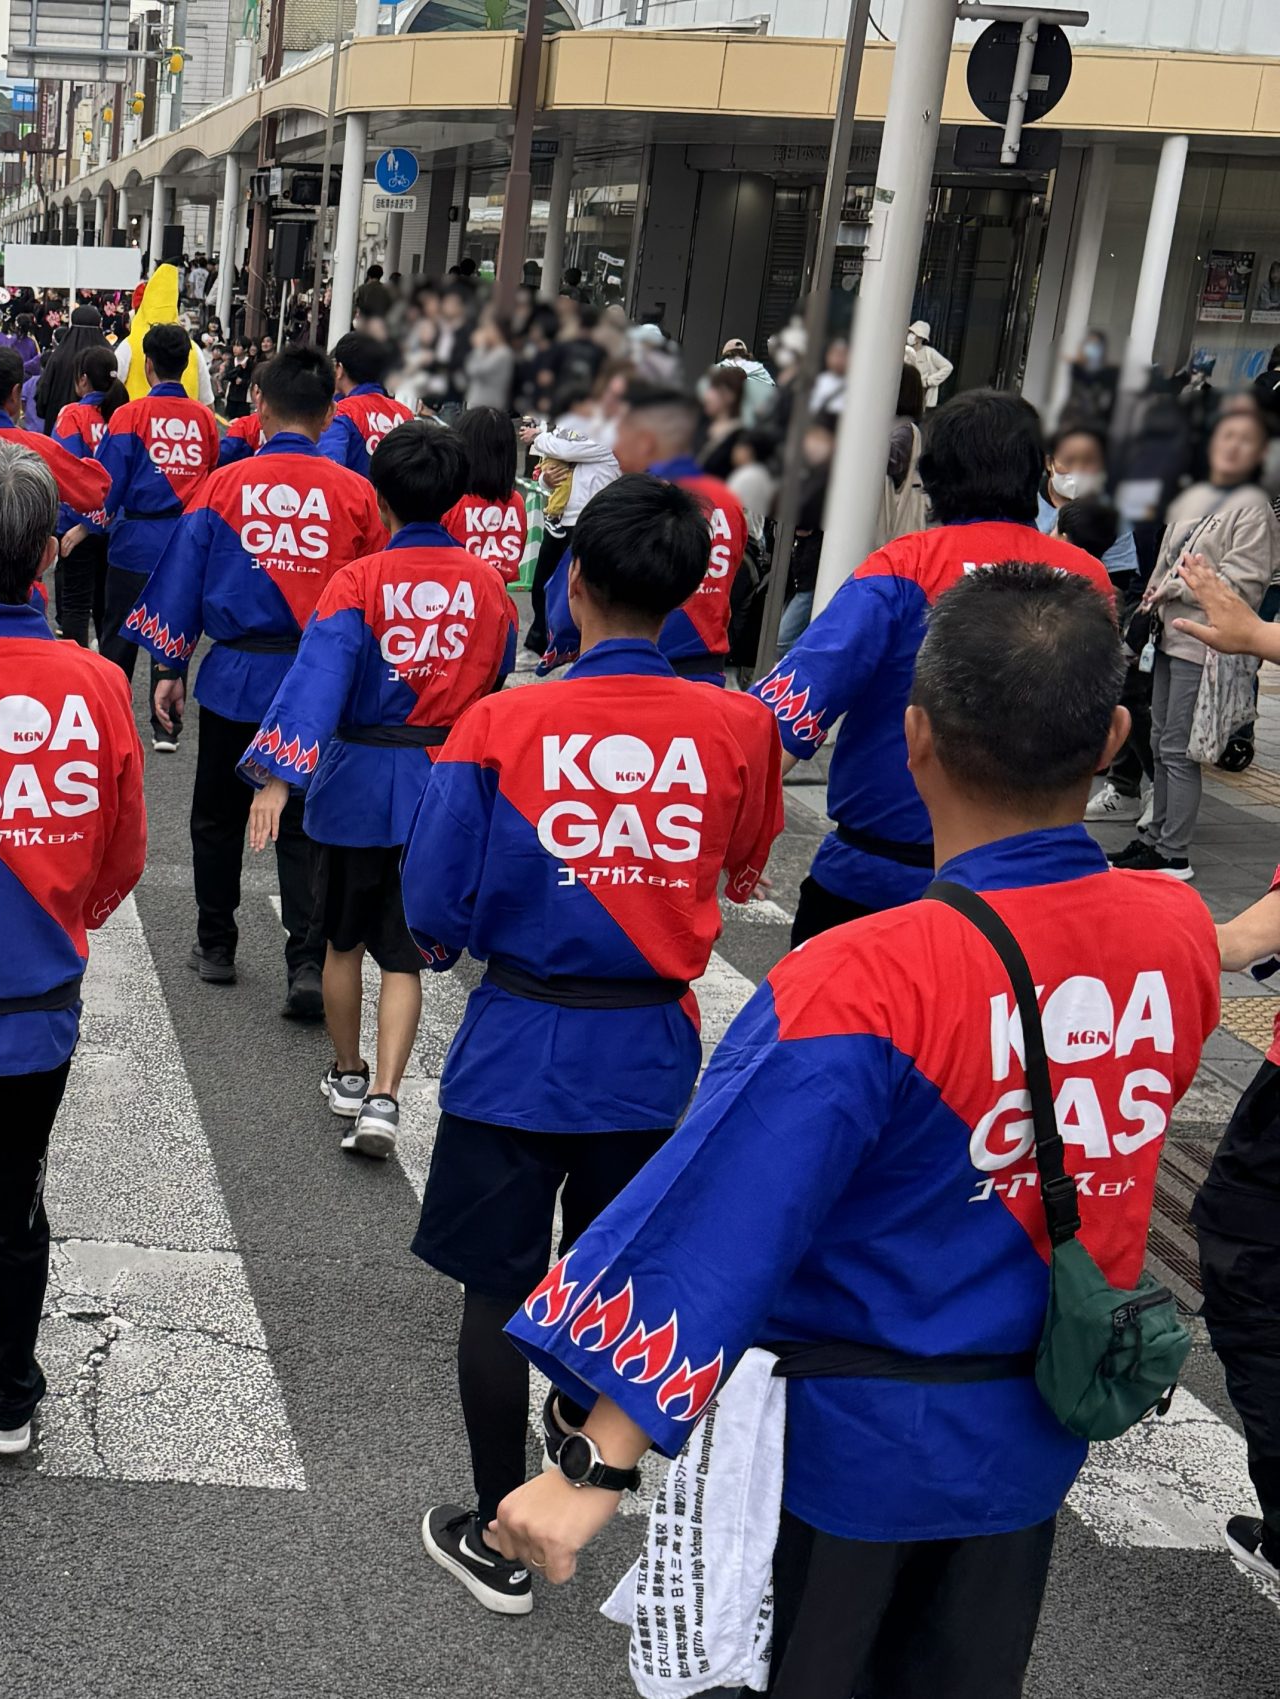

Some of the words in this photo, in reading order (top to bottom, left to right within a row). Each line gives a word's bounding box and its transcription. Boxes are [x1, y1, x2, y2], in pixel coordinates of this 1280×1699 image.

[150, 417, 202, 441] KOA
[149, 441, 202, 467] GAS
[242, 483, 331, 521] KOA
[464, 506, 522, 532] KOA
[241, 520, 329, 559] GAS
[465, 535, 522, 561] GAS
[382, 580, 476, 621] KOA
[380, 623, 469, 665] GAS
[13, 731, 44, 742] KGN
[542, 734, 708, 795] KOA
[615, 771, 646, 782] KGN
[536, 800, 704, 863] GAS
[557, 865, 690, 888] コーアガス日本
[989, 970, 1176, 1082] KOA
[1066, 1030, 1112, 1047] KGN
[969, 1068, 1172, 1172] GAS
[696, 1399, 720, 1476] Championship
[690, 1477, 706, 1524] Baseball
[689, 1527, 703, 1558] School
[690, 1558, 706, 1580] High
[691, 1582, 705, 1628] National
[654, 1605, 672, 1678] 日大山形高校
[699, 1659, 711, 1674] The
